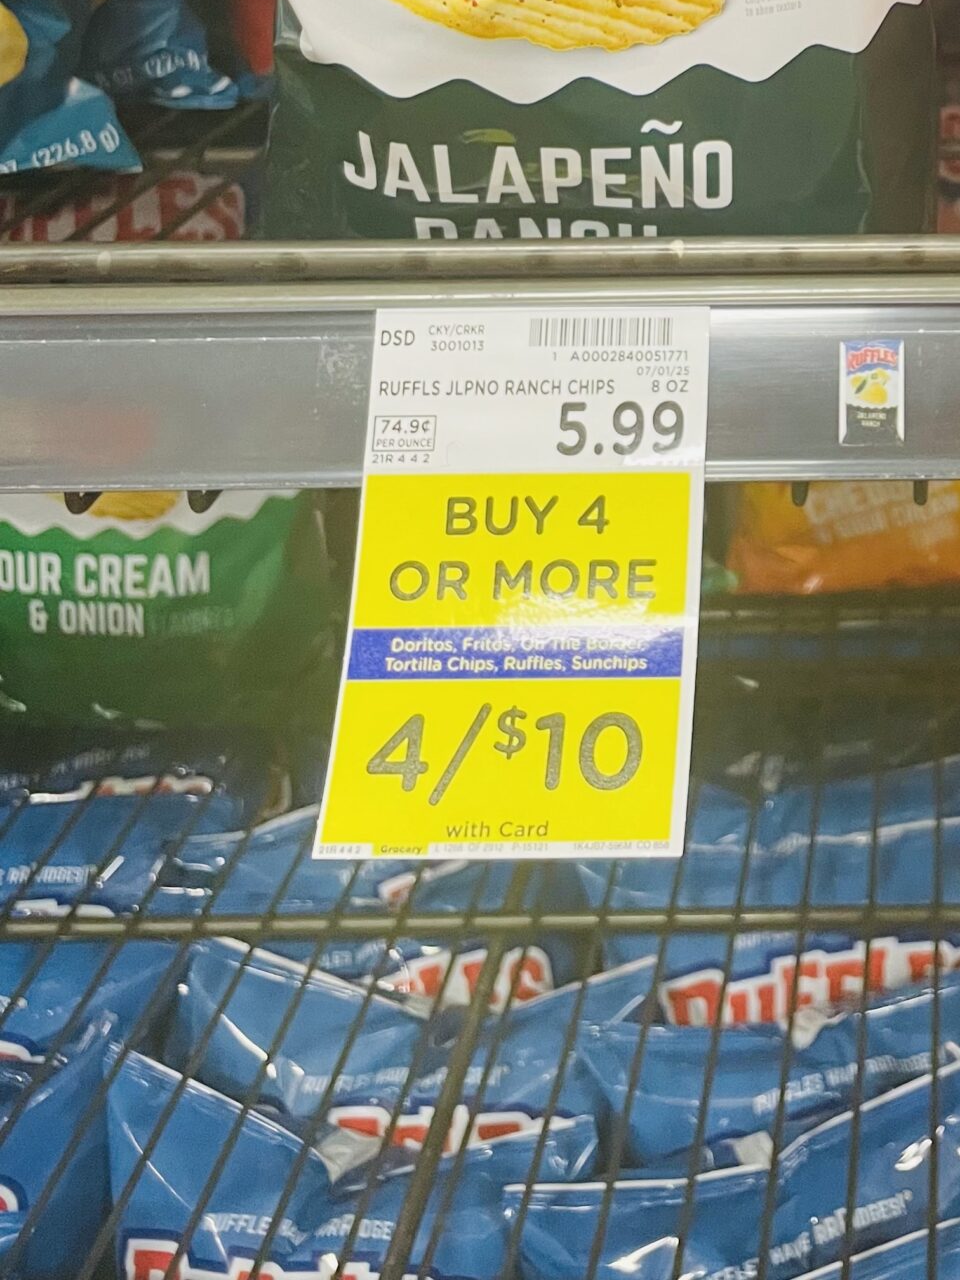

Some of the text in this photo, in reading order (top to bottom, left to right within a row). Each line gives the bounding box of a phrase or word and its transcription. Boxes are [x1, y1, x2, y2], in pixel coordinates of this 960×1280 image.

[343, 119, 733, 209] JALAPEÑO
[380, 329, 415, 347] DSD
[428, 323, 485, 337] CKY/CRKR
[430, 340, 485, 352] 3001013
[570, 350, 689, 362] A0002840051771
[636, 365, 690, 377] 07/01/25
[379, 379, 689, 396] RUFFLS JLPNO RANCH CHIPS 8 OZ
[380, 419, 431, 435] 74.9¢
[556, 399, 685, 456] 5.99
[376, 437, 433, 448] PER OUNCE
[445, 494, 610, 536] BUY 4
[73, 550, 211, 599] CREAM
[389, 558, 658, 602] OR MORE
[58, 600, 145, 638] ONION
[390, 637, 456, 654] Doritos,
[462, 636, 514, 653] Fritos,
[385, 654, 648, 673] Tortilla Chips, Ruffles, Sunchips
[366, 702, 644, 806] 4/$10
[446, 820, 549, 838] with Card
